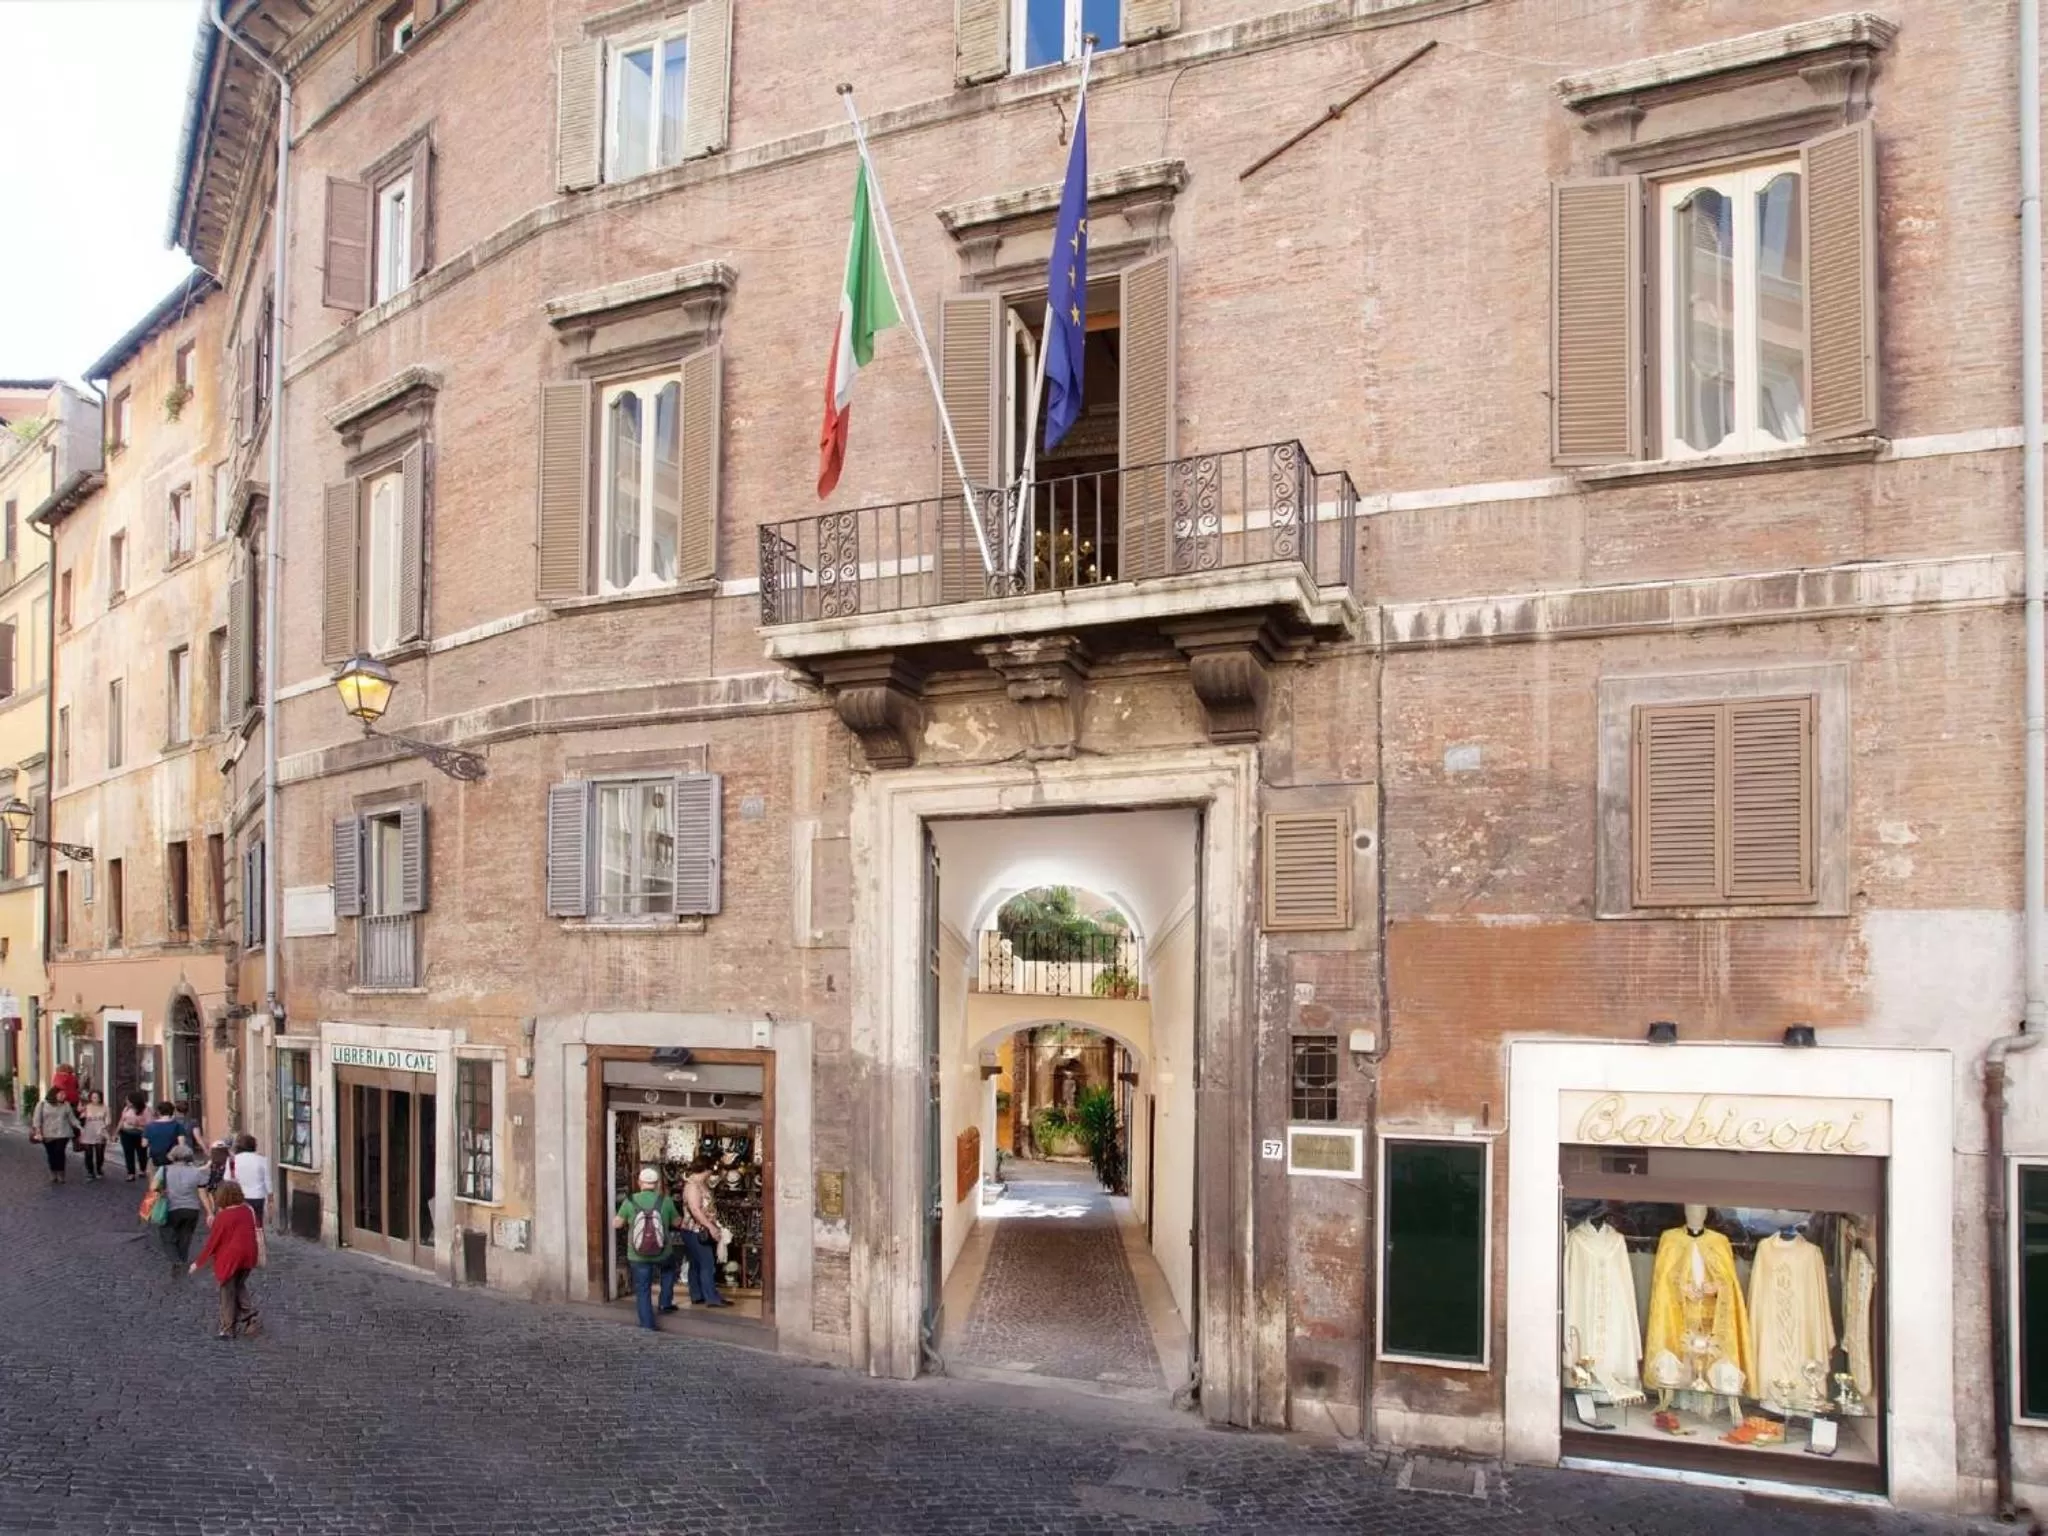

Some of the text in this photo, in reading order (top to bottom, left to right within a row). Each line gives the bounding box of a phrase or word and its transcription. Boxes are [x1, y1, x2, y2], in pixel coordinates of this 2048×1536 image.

[333, 1046, 434, 1071] LIBRERIA DI CAVE
[1576, 1092, 1870, 1153] Barbiconi
[1264, 1142, 1281, 1156] 57
